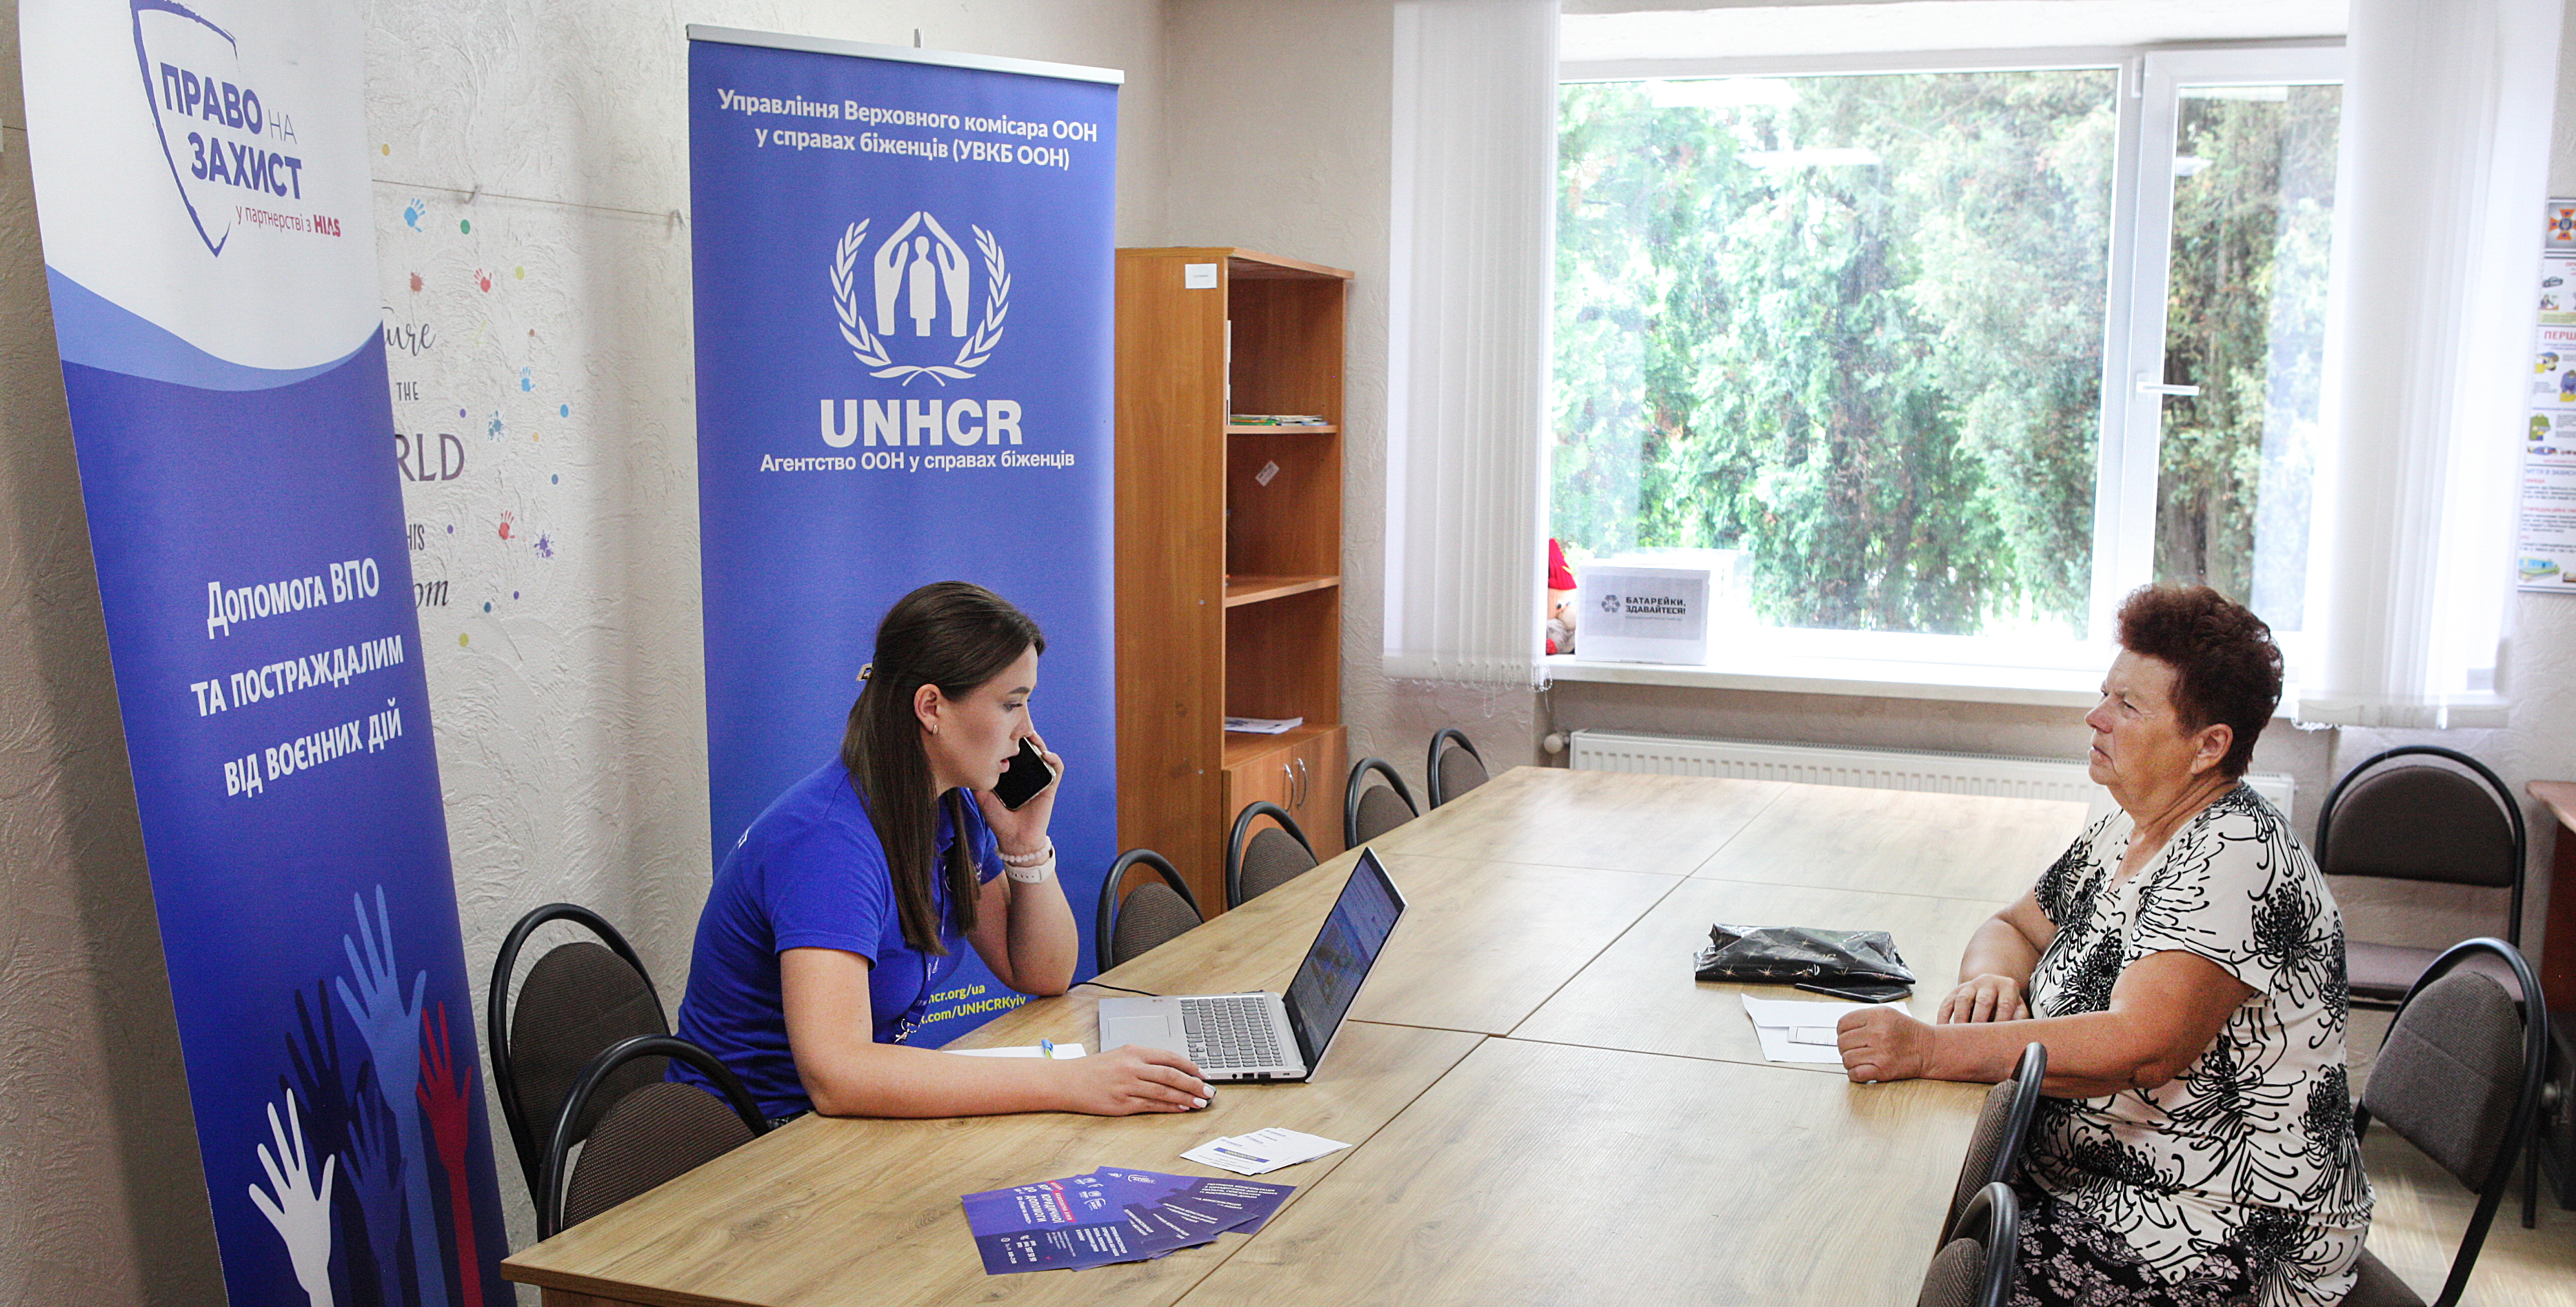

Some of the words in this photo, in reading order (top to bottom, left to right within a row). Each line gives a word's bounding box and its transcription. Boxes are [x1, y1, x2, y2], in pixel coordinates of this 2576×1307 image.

[160, 62, 262, 134] ПРАВО
[268, 109, 297, 145] НА
[718, 88, 839, 119] Управління
[845, 101, 960, 131] Верховного
[965, 115, 1047, 140] комісара
[1053, 120, 1097, 142] ООН
[188, 132, 302, 199] ЗАХИСТ
[756, 126, 768, 147] у
[773, 130, 855, 152] справах
[860, 131, 948, 160] біженців
[953, 141, 1013, 163] (УВКБ
[1017, 144, 1070, 170] ООН)
[235, 205, 242, 225] у
[245, 207, 304, 232] партнерстві
[305, 219, 312, 232] з
[313, 214, 341, 237] HIAS
[383, 308, 436, 356] ure
[396, 381, 419, 401] THE
[821, 398, 1023, 448] UNHCR
[761, 454, 856, 472] Агентство
[861, 452, 904, 470] ООН
[909, 455, 918, 472] у
[924, 454, 996, 472] справах
[1001, 450, 1075, 469] біженців
[207, 576, 328, 640] Допомога
[330, 558, 379, 603] ВПО
[1625, 605, 1686, 614] ЗДАВАЙТЕСЯ!
[190, 678, 227, 717] ТА
[231, 635, 404, 709] ПОСТРАЖДАЛИМ
[224, 753, 263, 798] ВІД
[265, 720, 363, 781] ВОЄННИХ
[368, 697, 402, 753] ДІЙ
